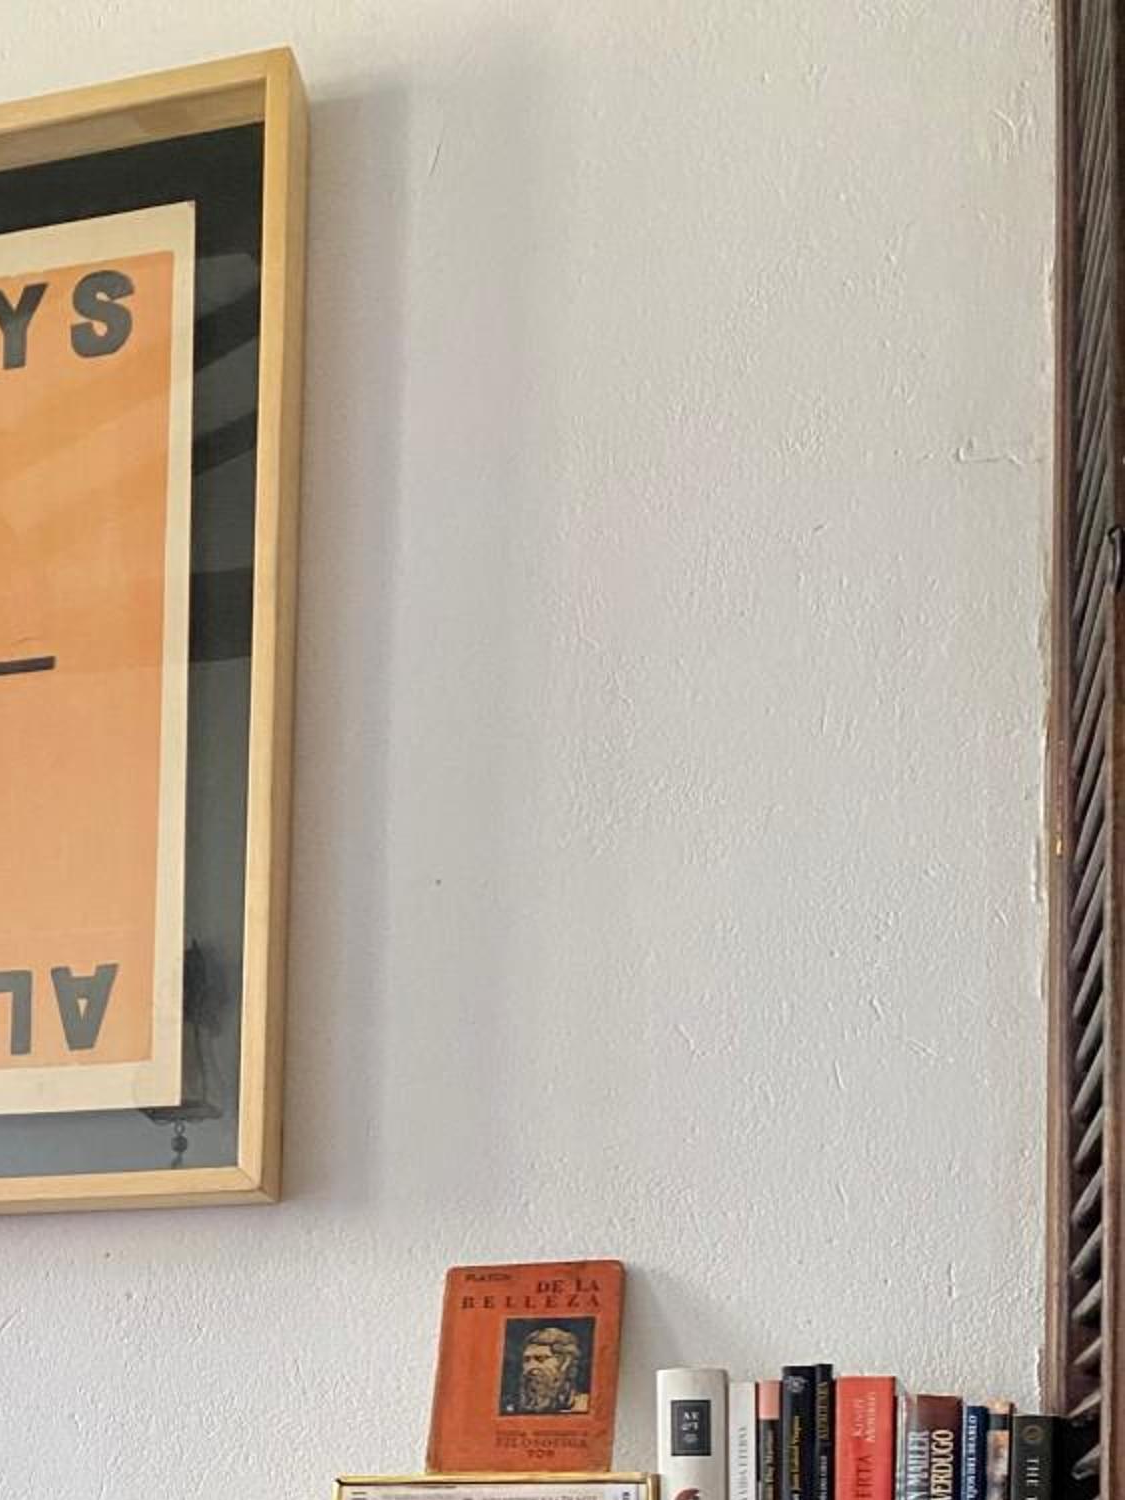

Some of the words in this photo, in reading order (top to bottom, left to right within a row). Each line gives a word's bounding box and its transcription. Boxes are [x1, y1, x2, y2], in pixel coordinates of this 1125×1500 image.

[537, 1279, 564, 1294] DE
[575, 1277, 601, 1293] LA
[461, 1294, 601, 1310] BELLEZA
[906, 1430, 929, 1487] MAILER
[1026, 1457, 1040, 1487] THE
